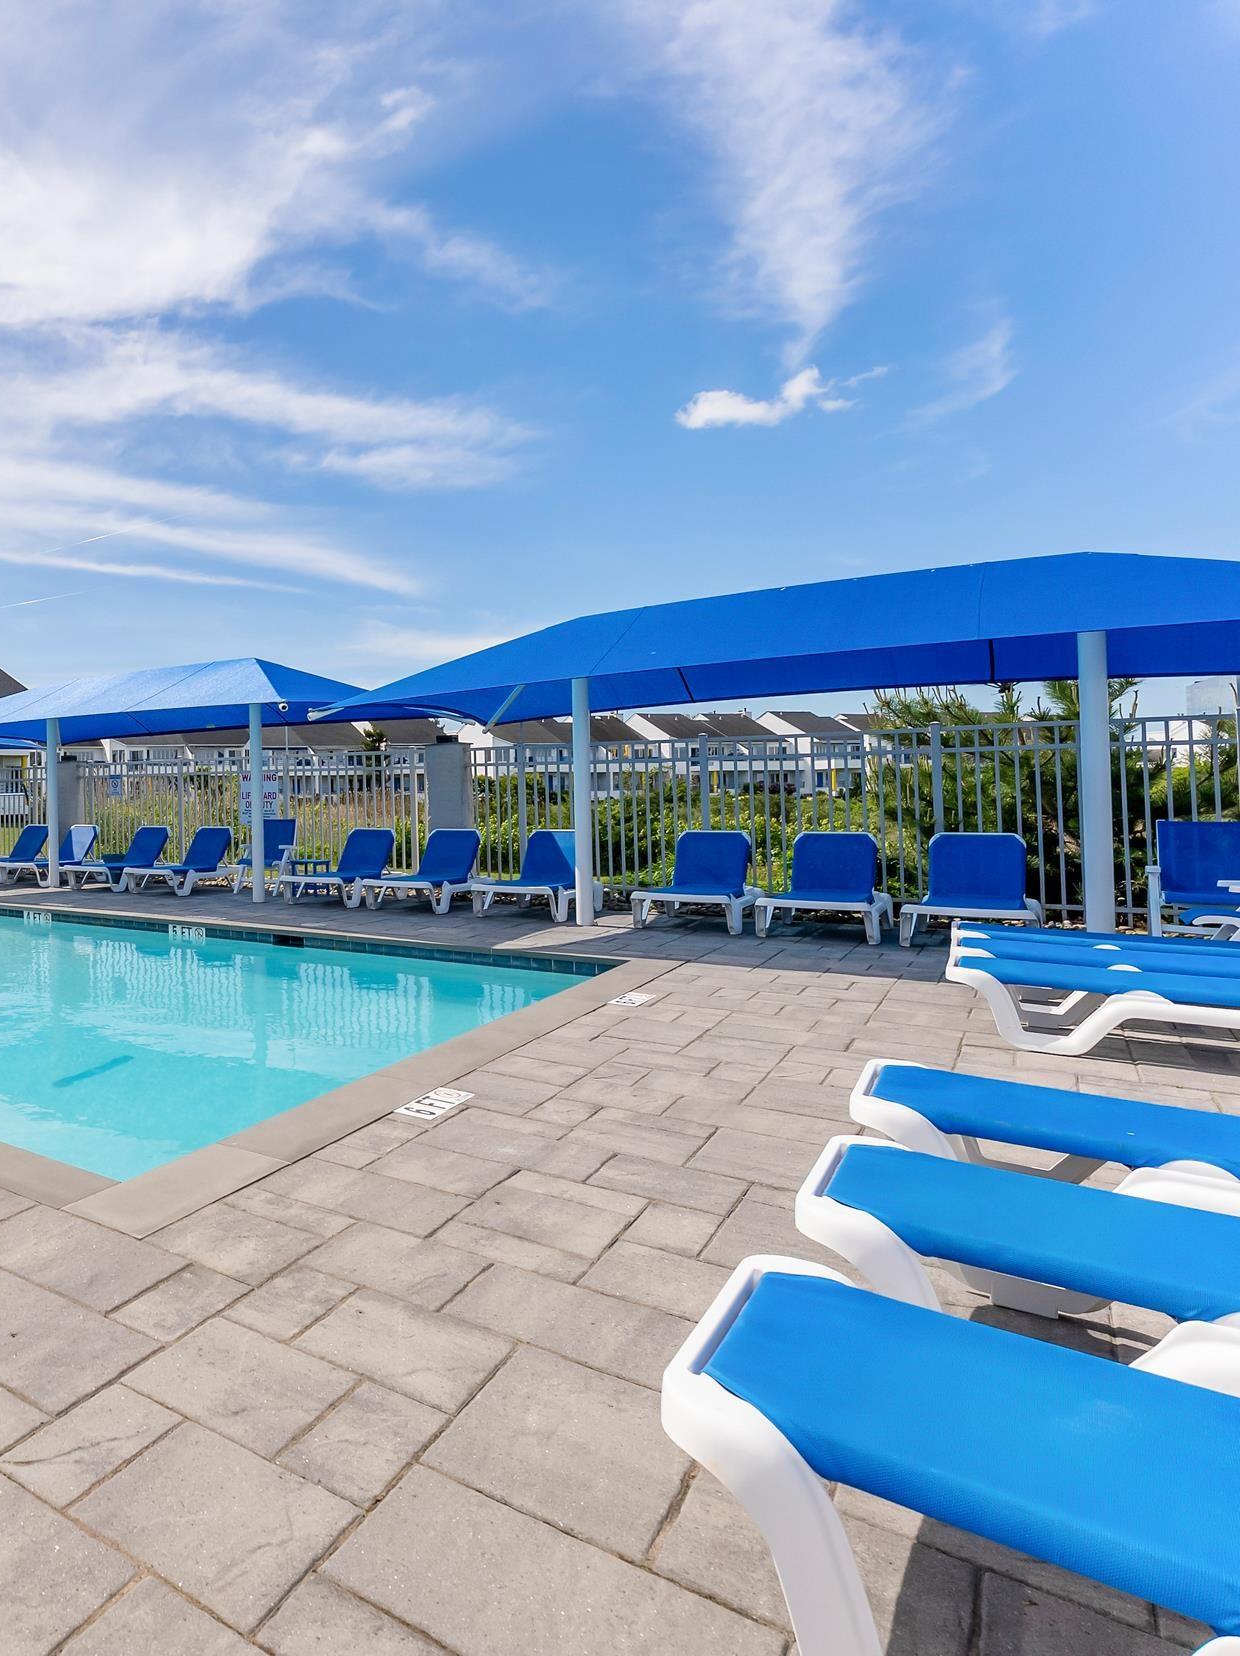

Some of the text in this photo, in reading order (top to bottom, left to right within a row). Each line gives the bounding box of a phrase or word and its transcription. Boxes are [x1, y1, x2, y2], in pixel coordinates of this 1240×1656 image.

[241, 774, 277, 782] WING
[241, 792, 277, 800] LIFARD
[173, 925, 192, 937] 5 FT
[403, 1095, 456, 1116] 6 FT
